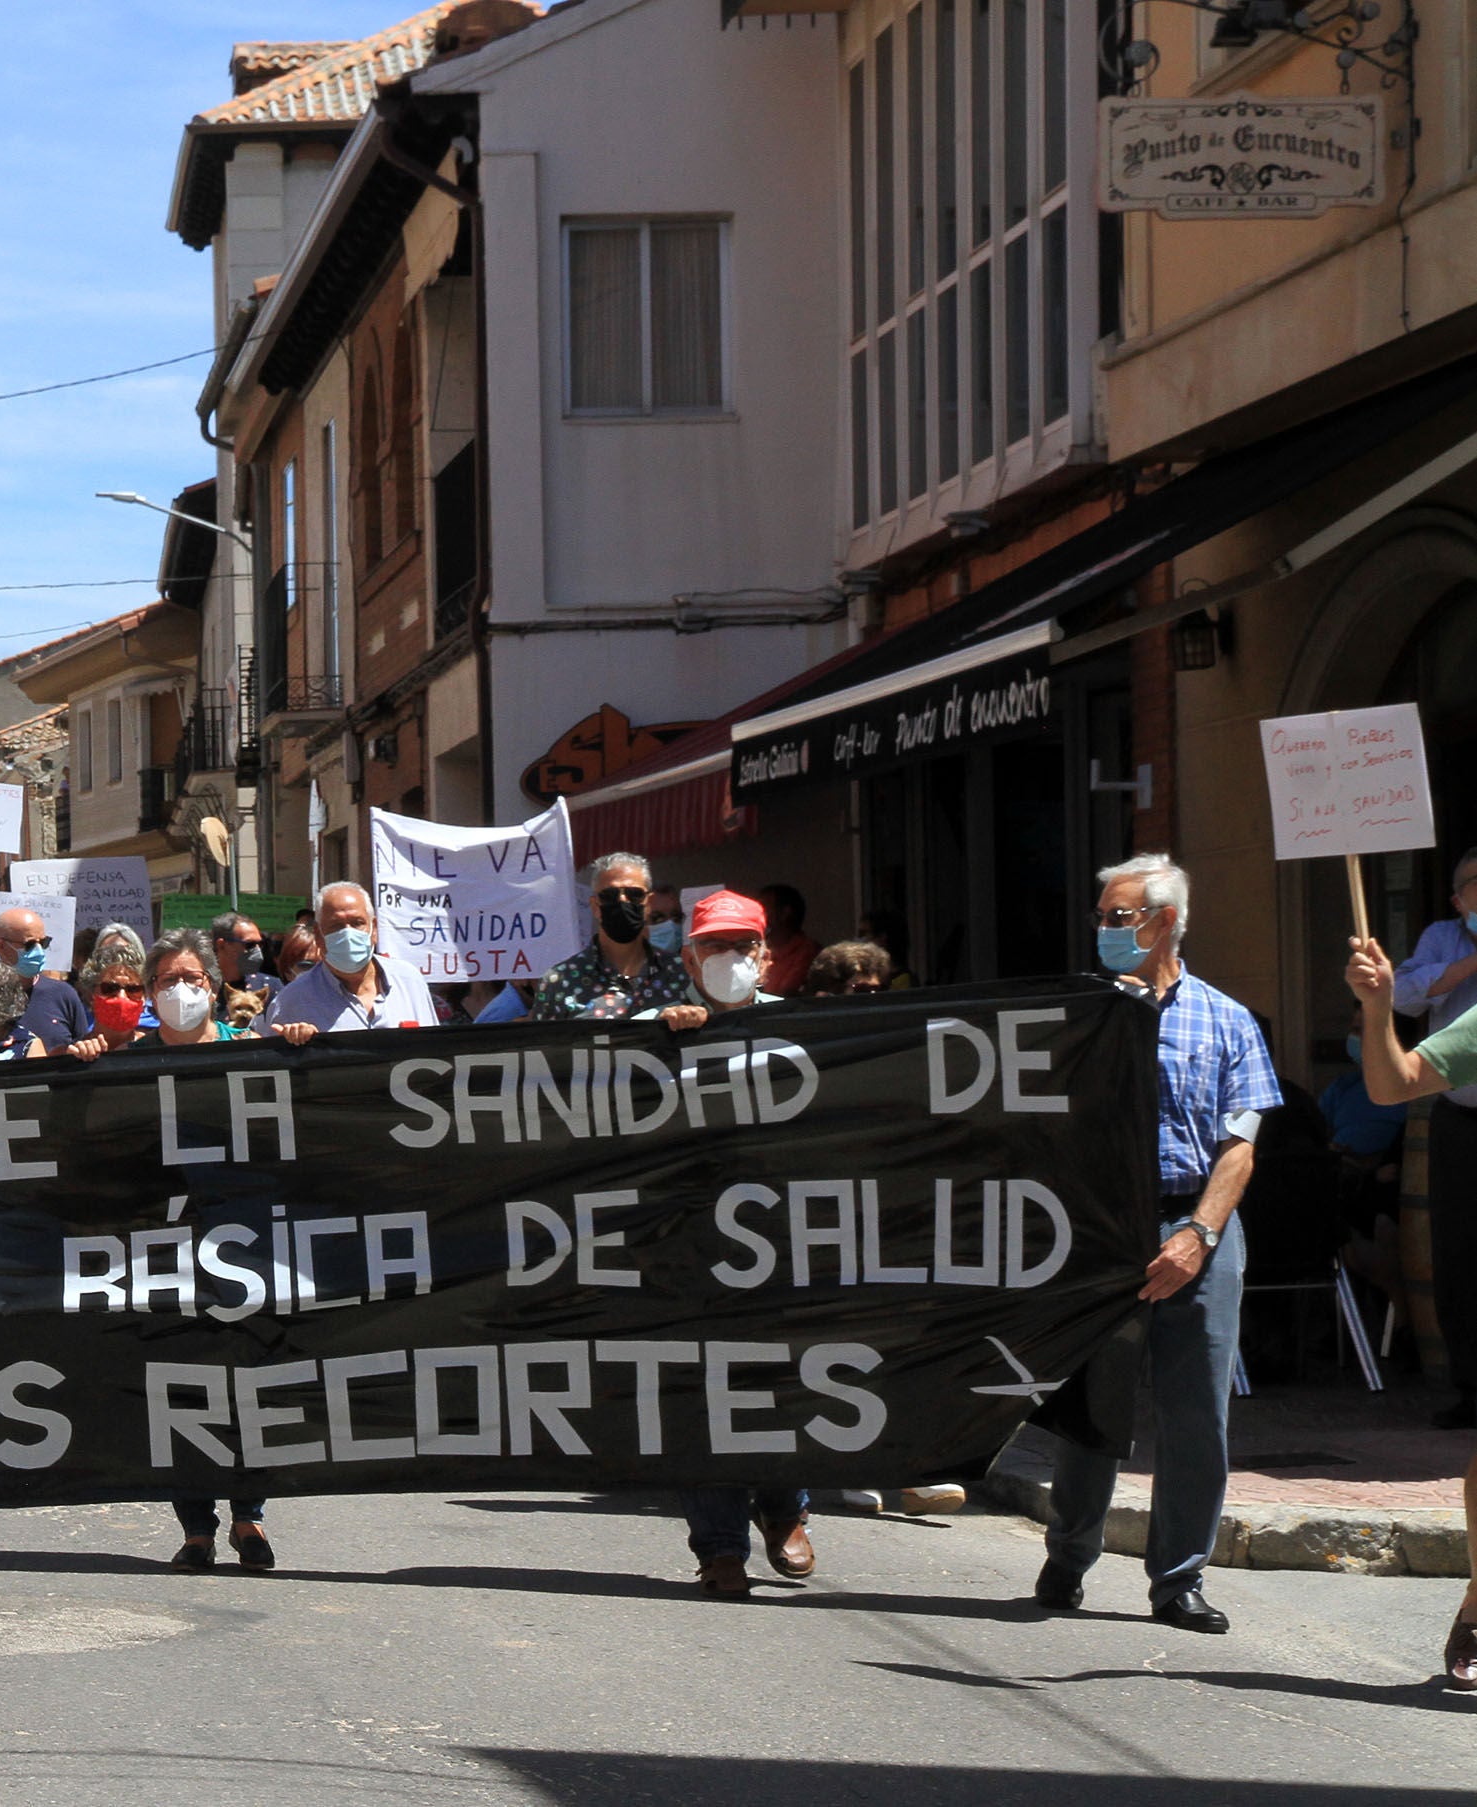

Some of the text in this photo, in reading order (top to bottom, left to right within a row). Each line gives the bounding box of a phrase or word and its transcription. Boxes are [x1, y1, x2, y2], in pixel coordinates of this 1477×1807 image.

[1233, 124, 1361, 169] Encuentro
[1257, 196, 1299, 207] BAR
[970, 667, 1050, 734] encuentro
[26, 871, 127, 887] EN DEFENSA
[83, 888, 146, 899] SANIDAD
[418, 893, 453, 909] UNA
[420, 950, 532, 977] JUSTA
[158, 1069, 297, 1166] LA
[926, 1007, 1069, 1115] DE
[504, 1189, 642, 1288] DE
[710, 1178, 1073, 1290] SALUD
[145, 1339, 888, 1469] RECORTES
